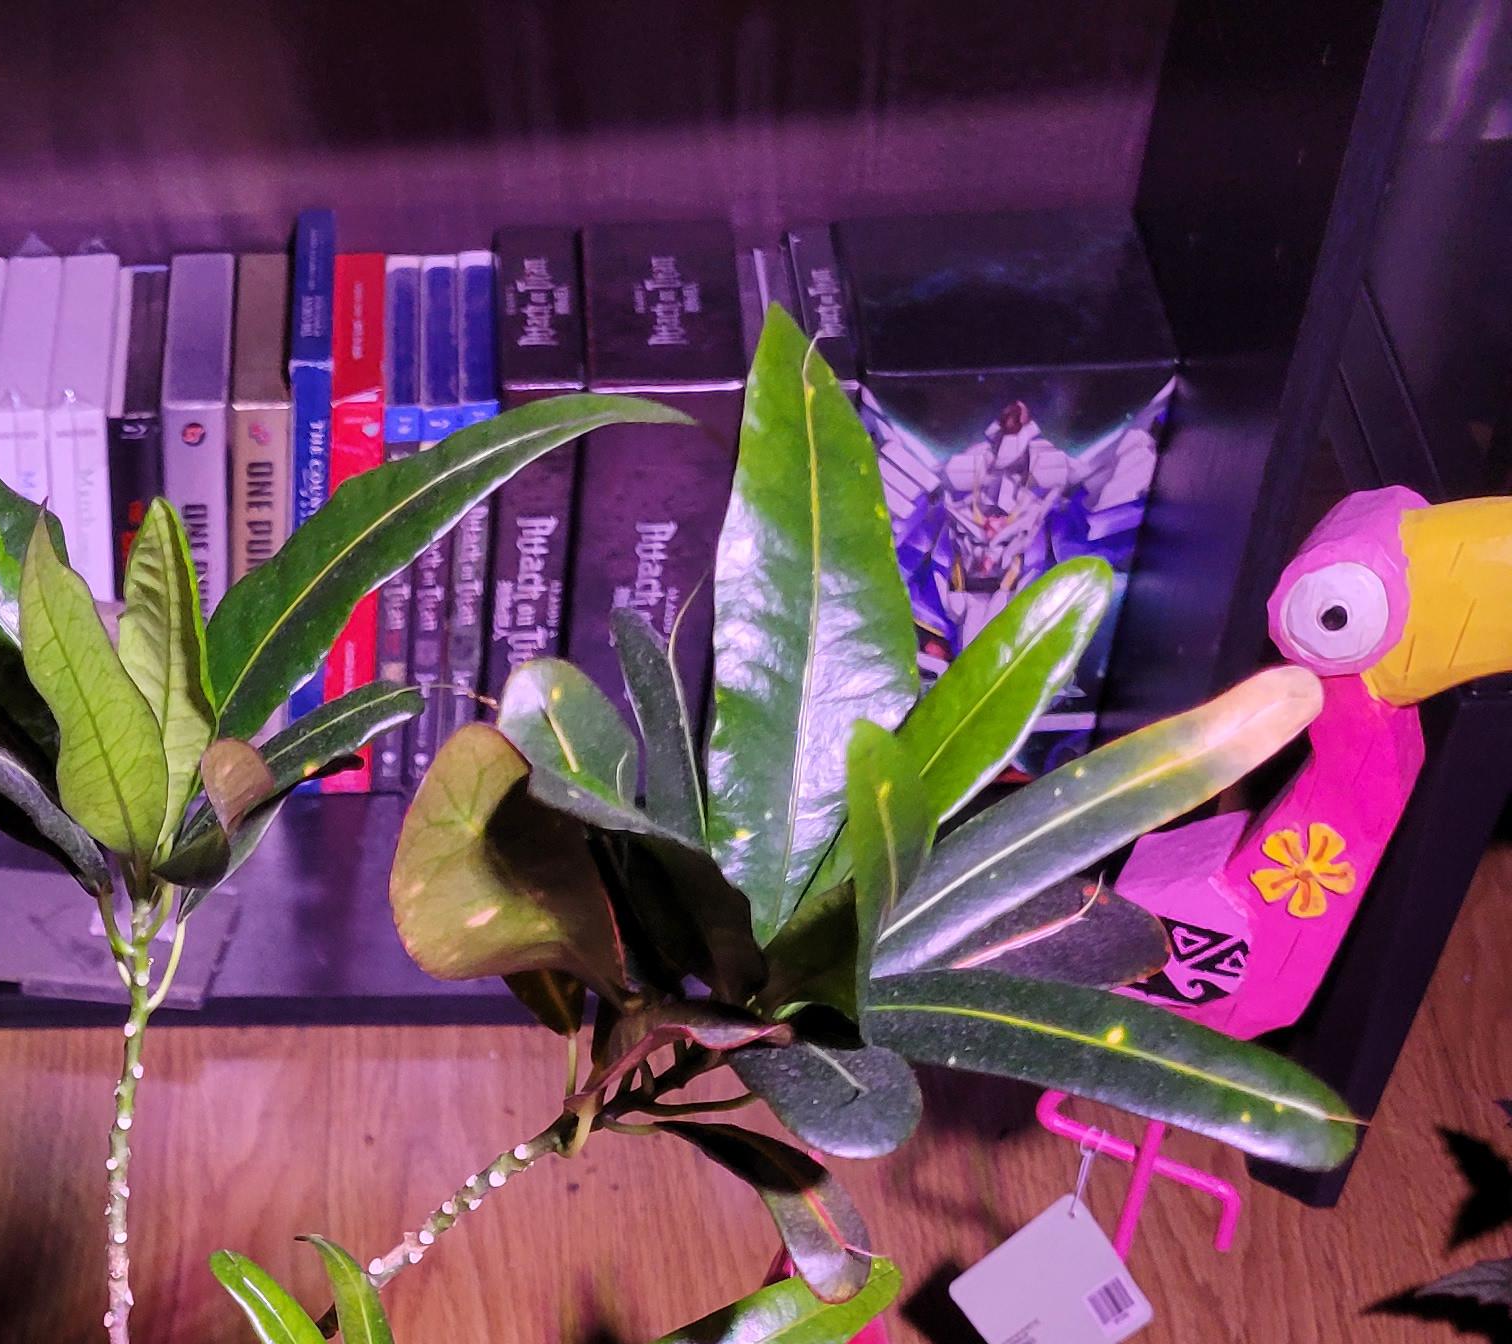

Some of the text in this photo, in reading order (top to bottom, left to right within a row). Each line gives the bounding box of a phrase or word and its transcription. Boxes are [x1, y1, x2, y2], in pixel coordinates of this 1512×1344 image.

[246, 461, 274, 514] ONE
[512, 515, 559, 600] Attack
[629, 521, 677, 607] Attack
[516, 603, 536, 626] on
